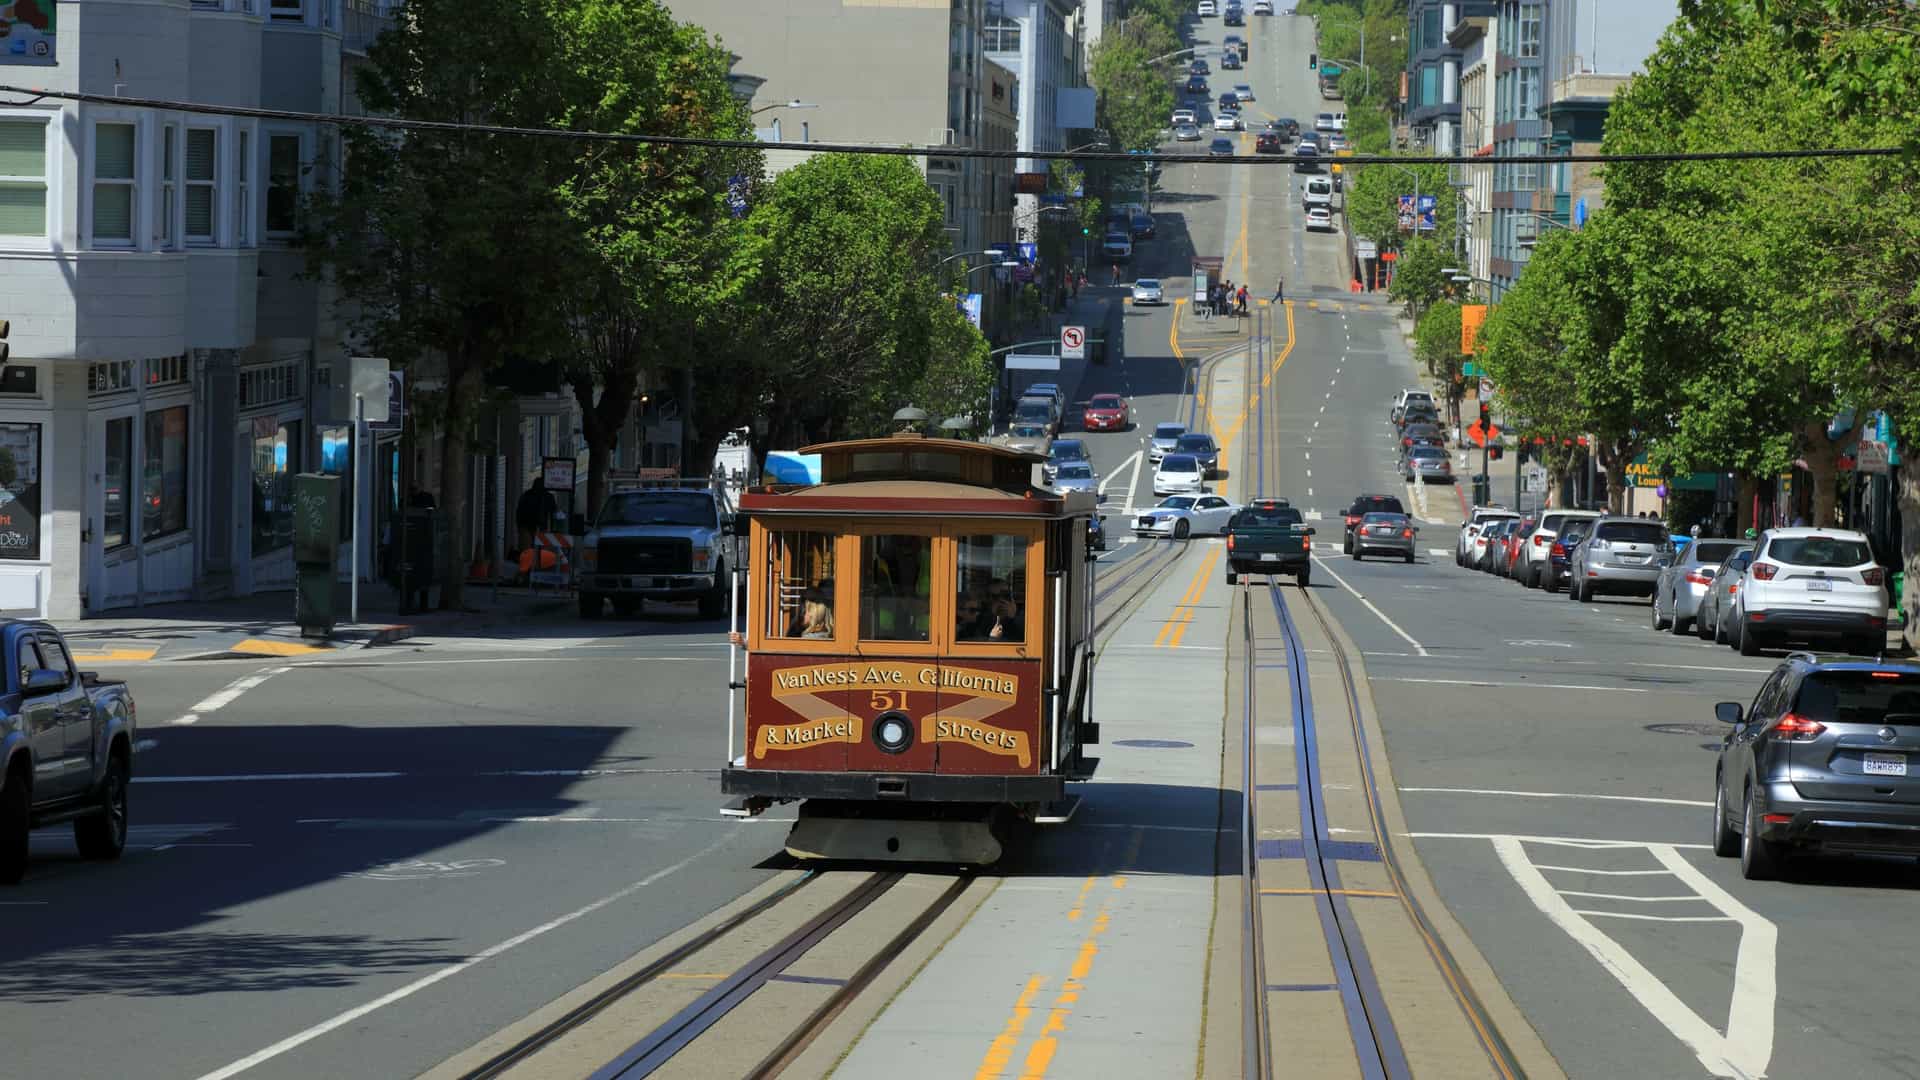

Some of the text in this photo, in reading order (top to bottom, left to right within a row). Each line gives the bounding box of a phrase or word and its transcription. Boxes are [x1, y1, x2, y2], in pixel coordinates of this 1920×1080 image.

[777, 672, 809, 689] Van
[813, 668, 858, 686] Ness
[919, 668, 1014, 694] California
[870, 690, 911, 711] 51
[767, 719, 853, 744] & Market
[937, 720, 1017, 749] Streets
